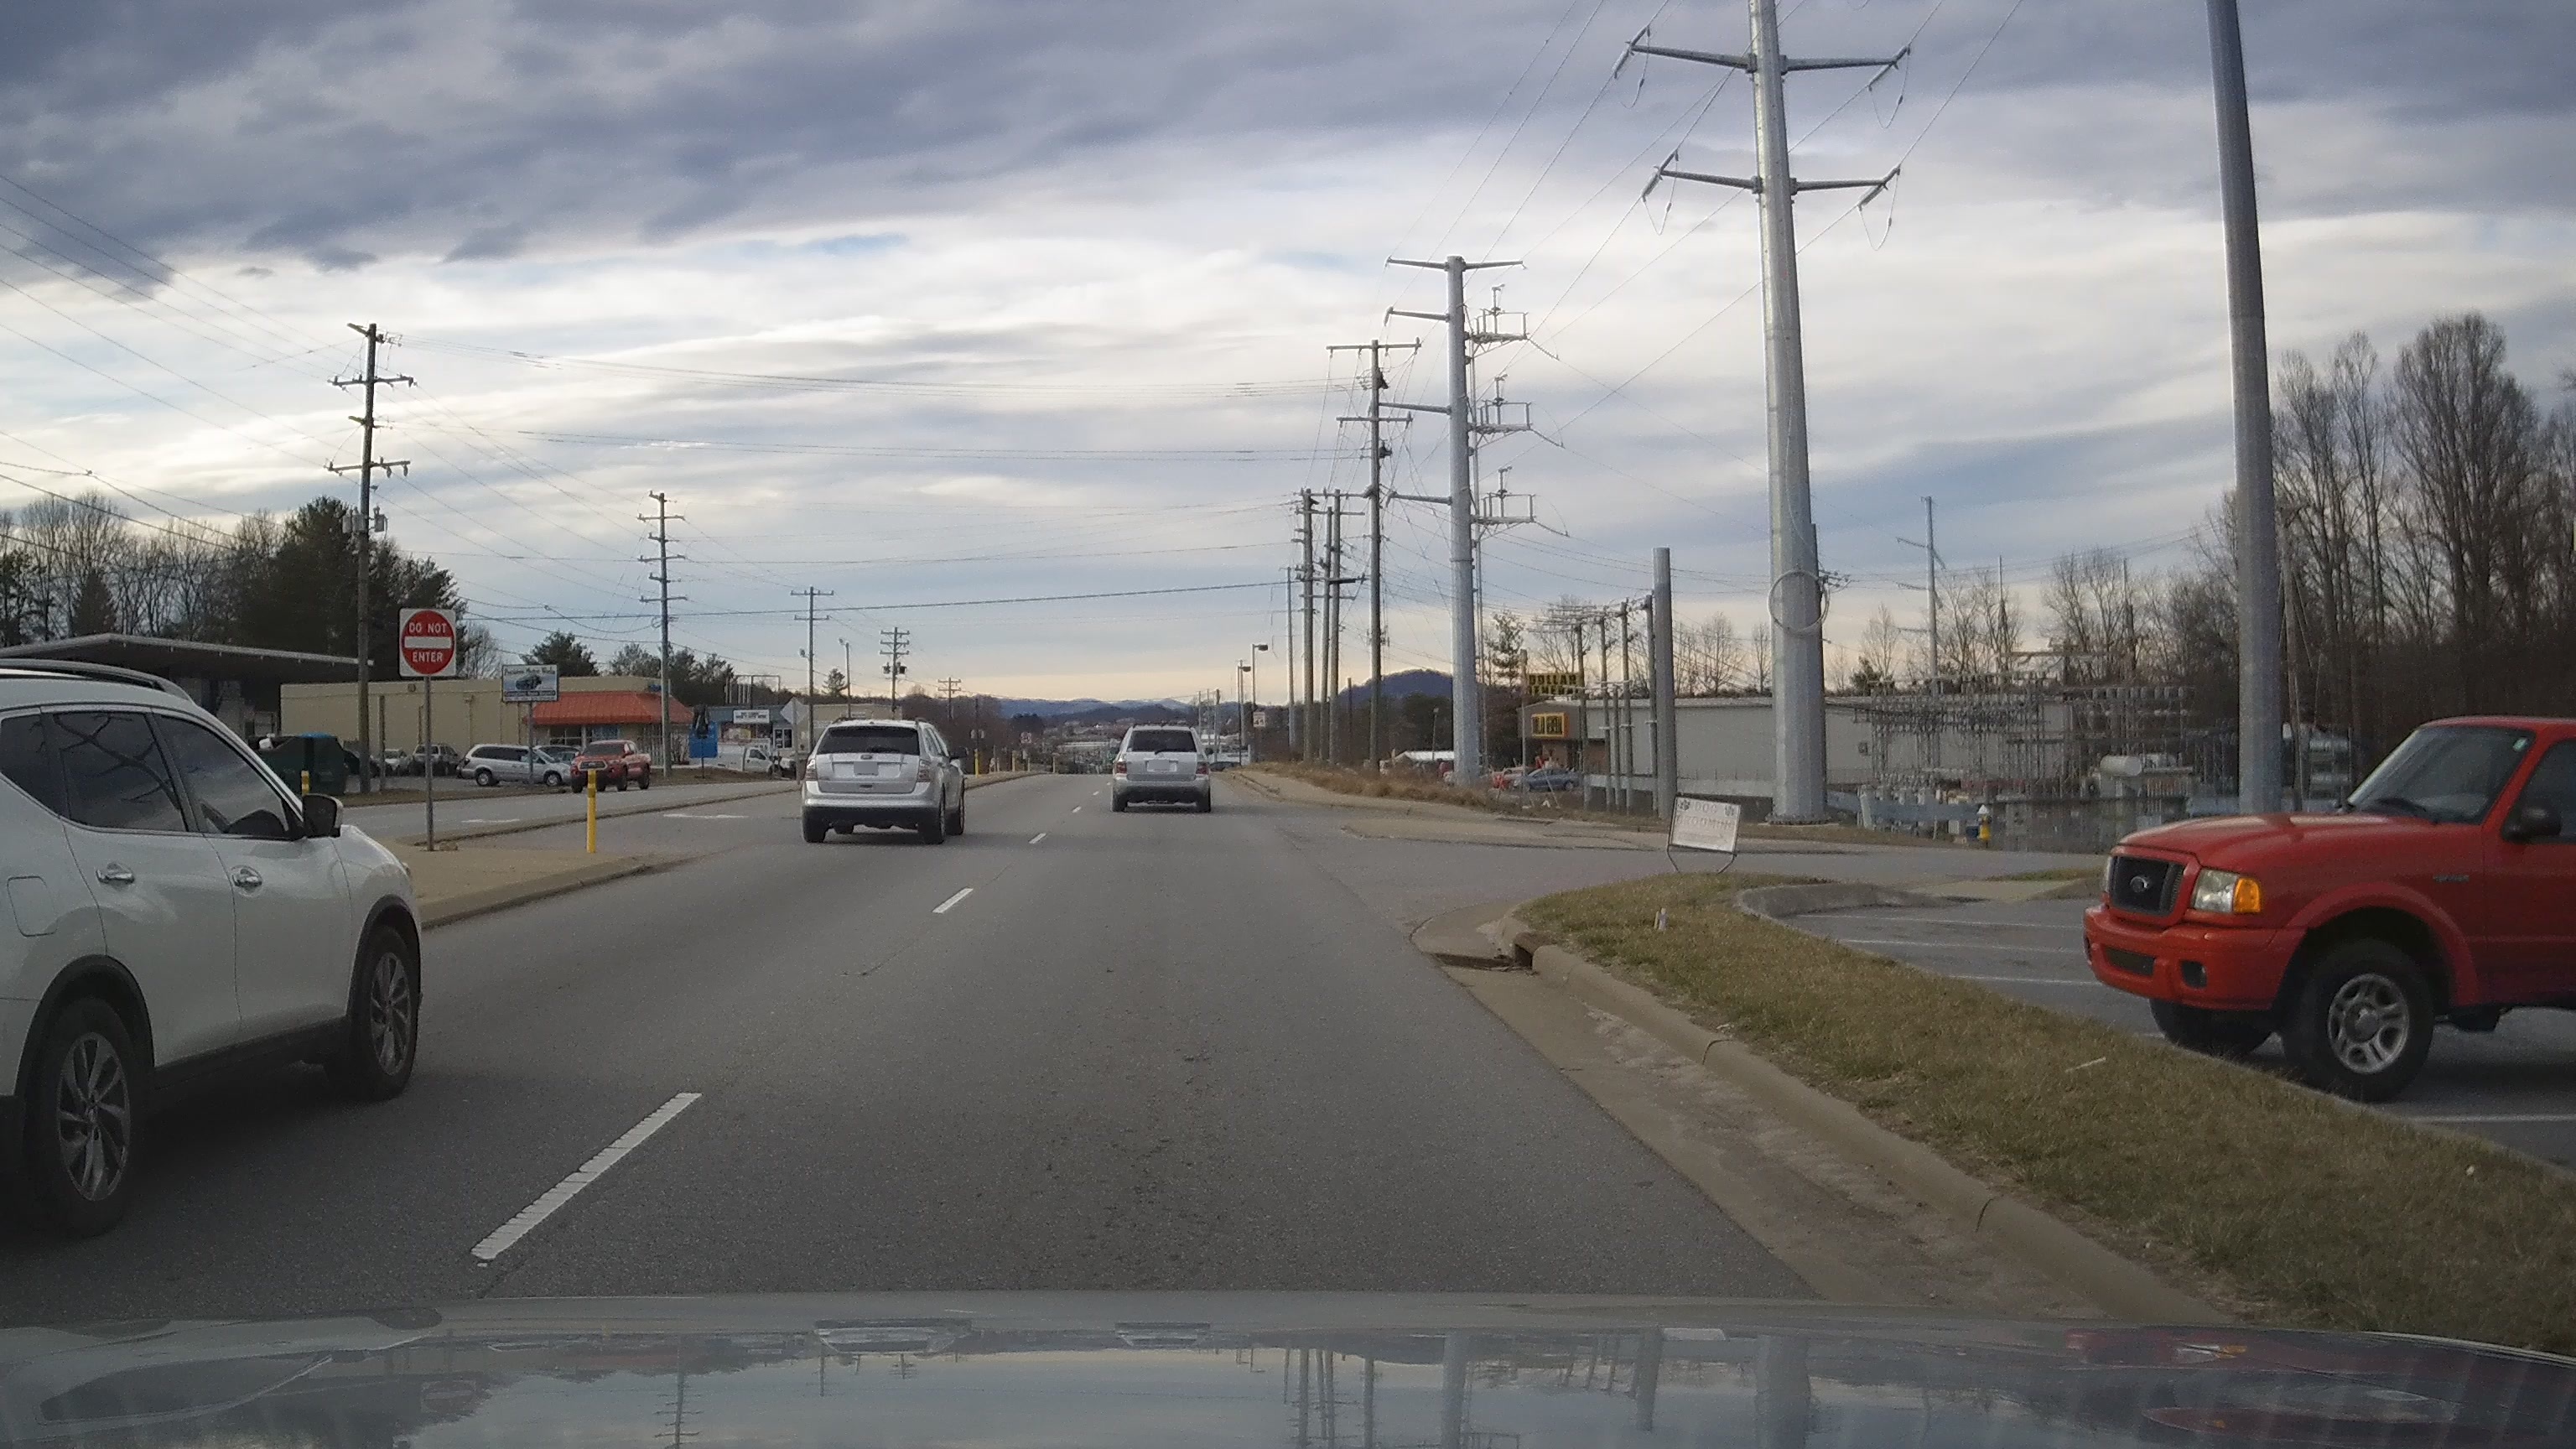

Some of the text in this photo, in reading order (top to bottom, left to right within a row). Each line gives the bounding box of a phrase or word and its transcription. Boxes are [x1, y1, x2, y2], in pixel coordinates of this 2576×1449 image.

[408, 622, 447, 633] DO NOT
[412, 652, 443, 662] ENTER
[1529, 674, 1576, 685] DOLLAR
